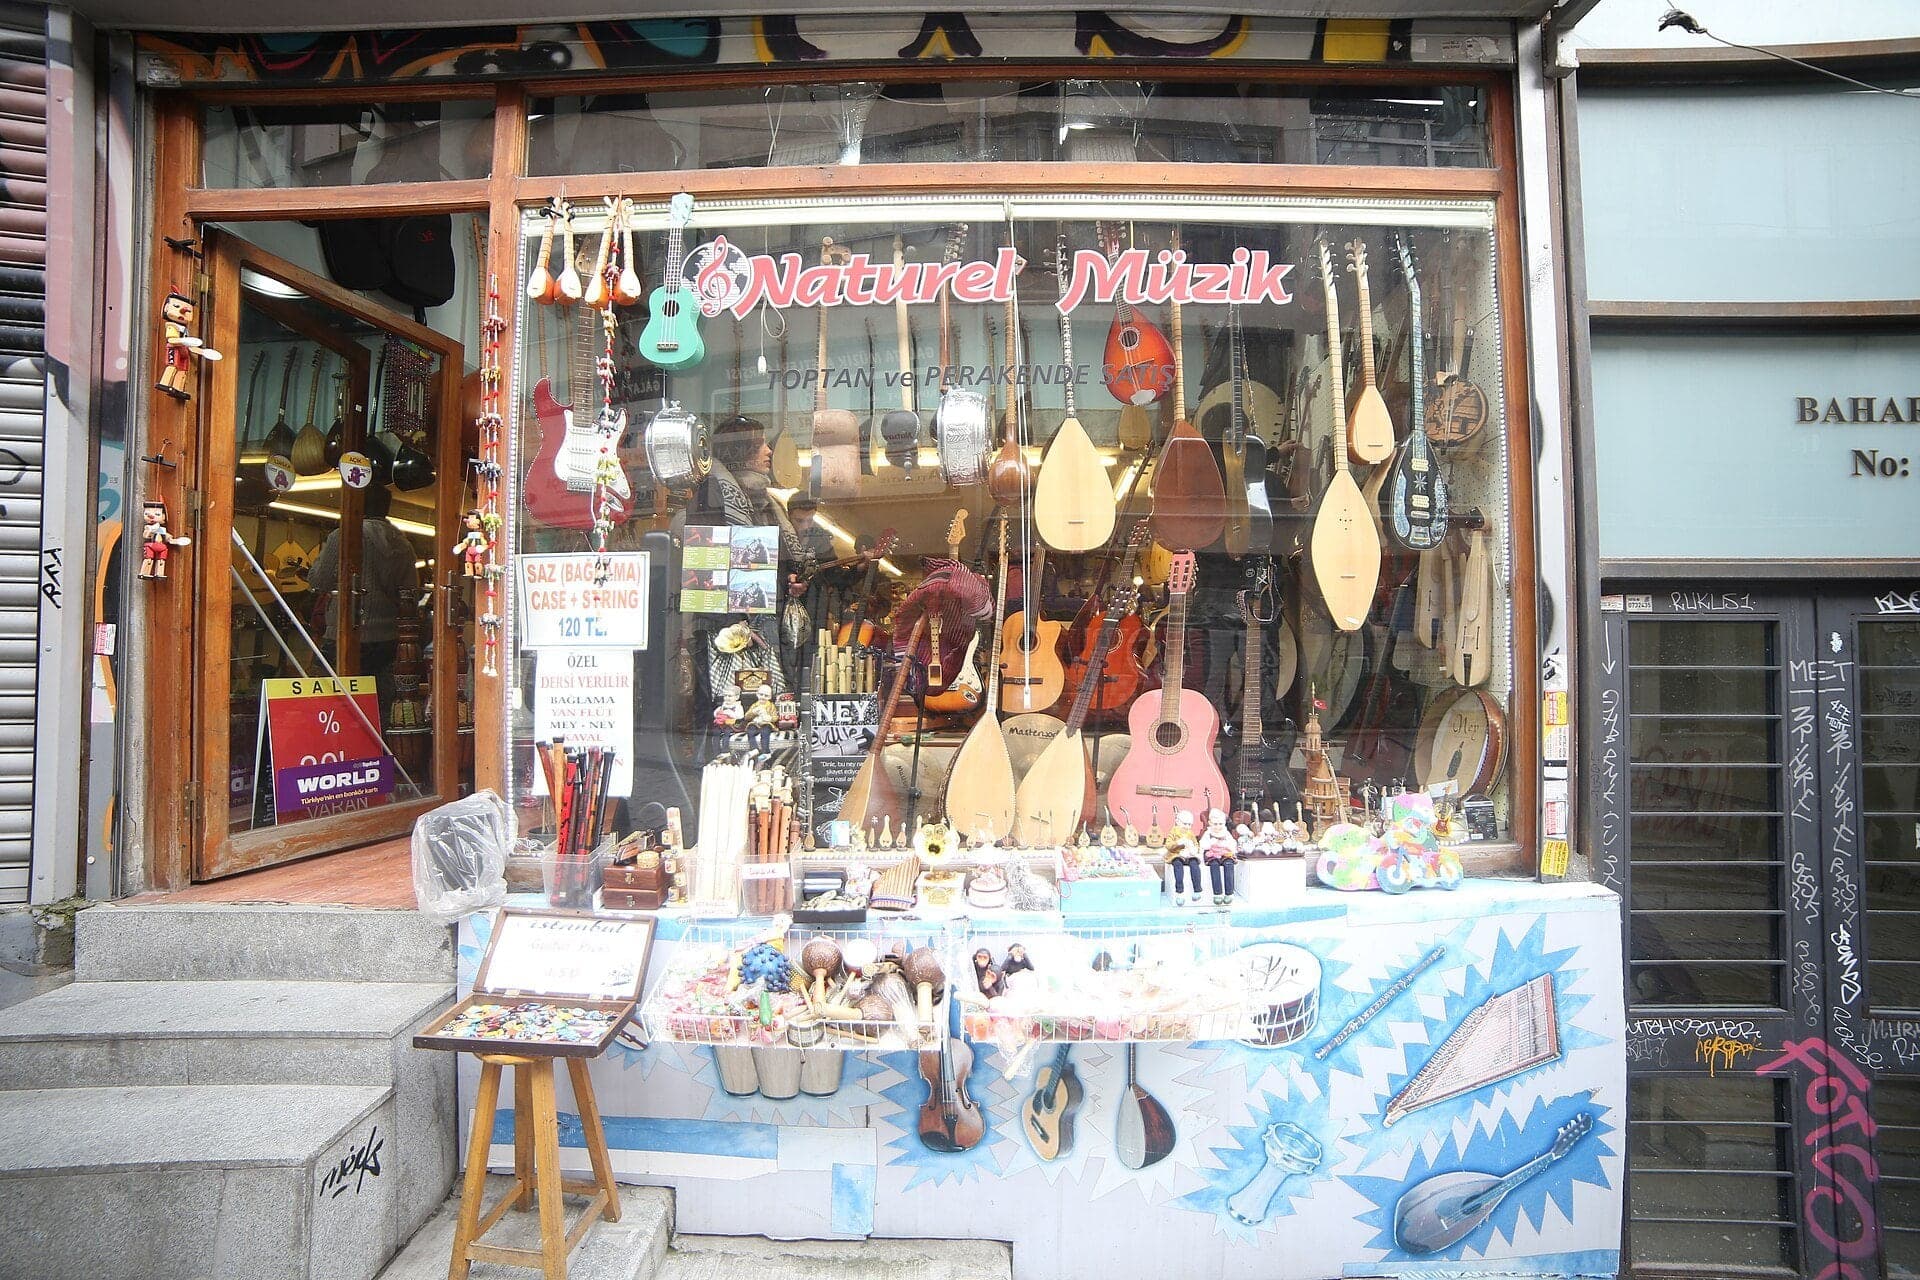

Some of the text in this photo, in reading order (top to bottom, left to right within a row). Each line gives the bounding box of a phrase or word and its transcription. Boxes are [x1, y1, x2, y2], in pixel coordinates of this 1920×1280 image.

[730, 246, 1295, 320] Naturel Müzik
[768, 362, 1174, 391] TOPTAN ve PERAKENDE SATIŞ
[1851, 449, 1910, 477] No:
[527, 563, 556, 583] SAZ
[531, 589, 639, 610] CASE + STRING
[558, 617, 581, 637] 120
[567, 652, 598, 668] ÖZEL
[292, 680, 359, 695] SALE
[541, 672, 629, 688] DERSİ VERİLİR
[550, 693, 615, 704] BAĞLAMA
[552, 709, 576, 717] YAN
[815, 700, 871, 723] NEY
[318, 710, 340, 735] %
[550, 721, 577, 729] MEY
[589, 721, 615, 729] NEY
[297, 768, 380, 793] WORLD
